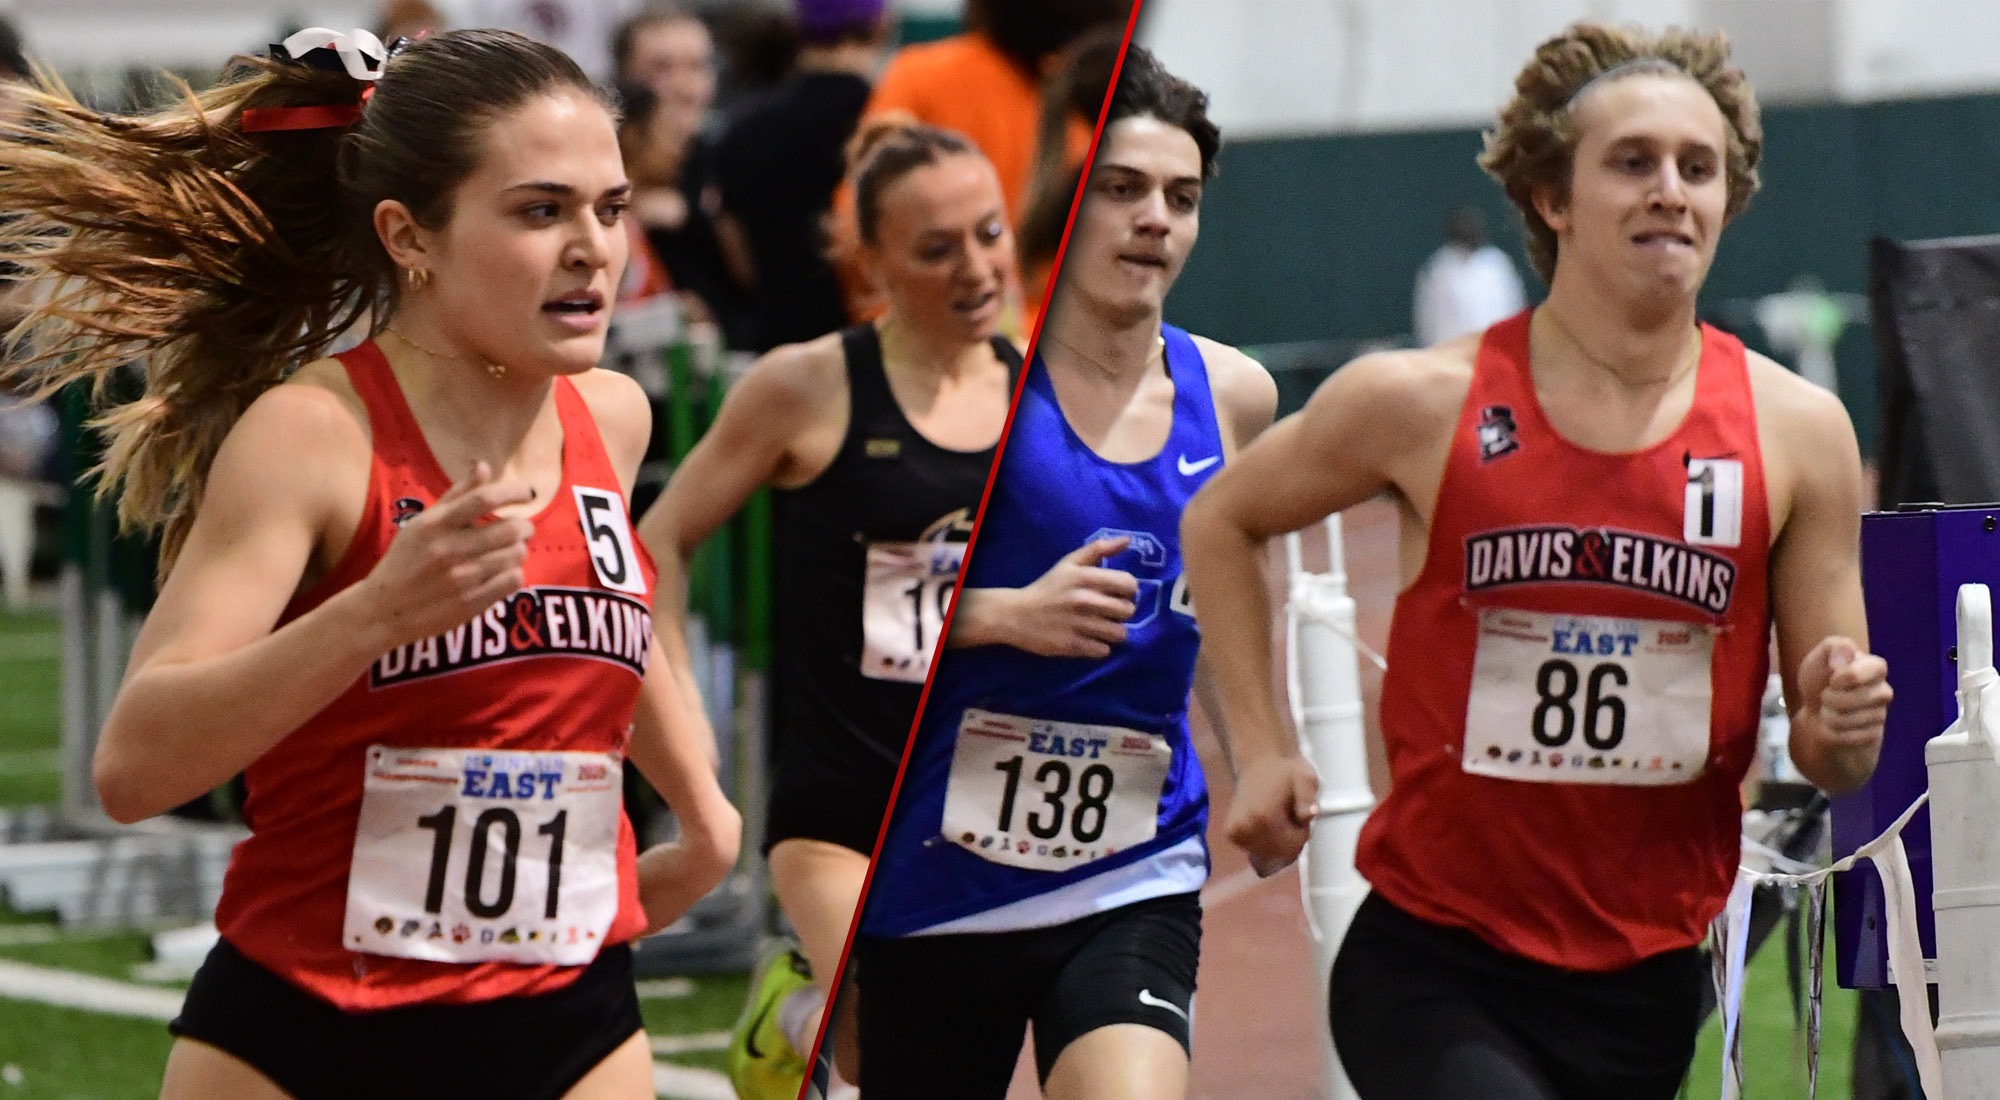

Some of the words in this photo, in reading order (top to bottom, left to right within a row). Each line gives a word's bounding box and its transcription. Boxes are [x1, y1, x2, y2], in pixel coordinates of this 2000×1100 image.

[580, 494, 626, 584] 5
[1688, 465, 1715, 538] 1
[1551, 631, 1639, 656] EAST
[1531, 658, 1628, 751] 86
[462, 769, 562, 800] EAST
[1028, 732, 1107, 758] EAST
[995, 755, 1114, 843] 138
[418, 805, 567, 920] 101
